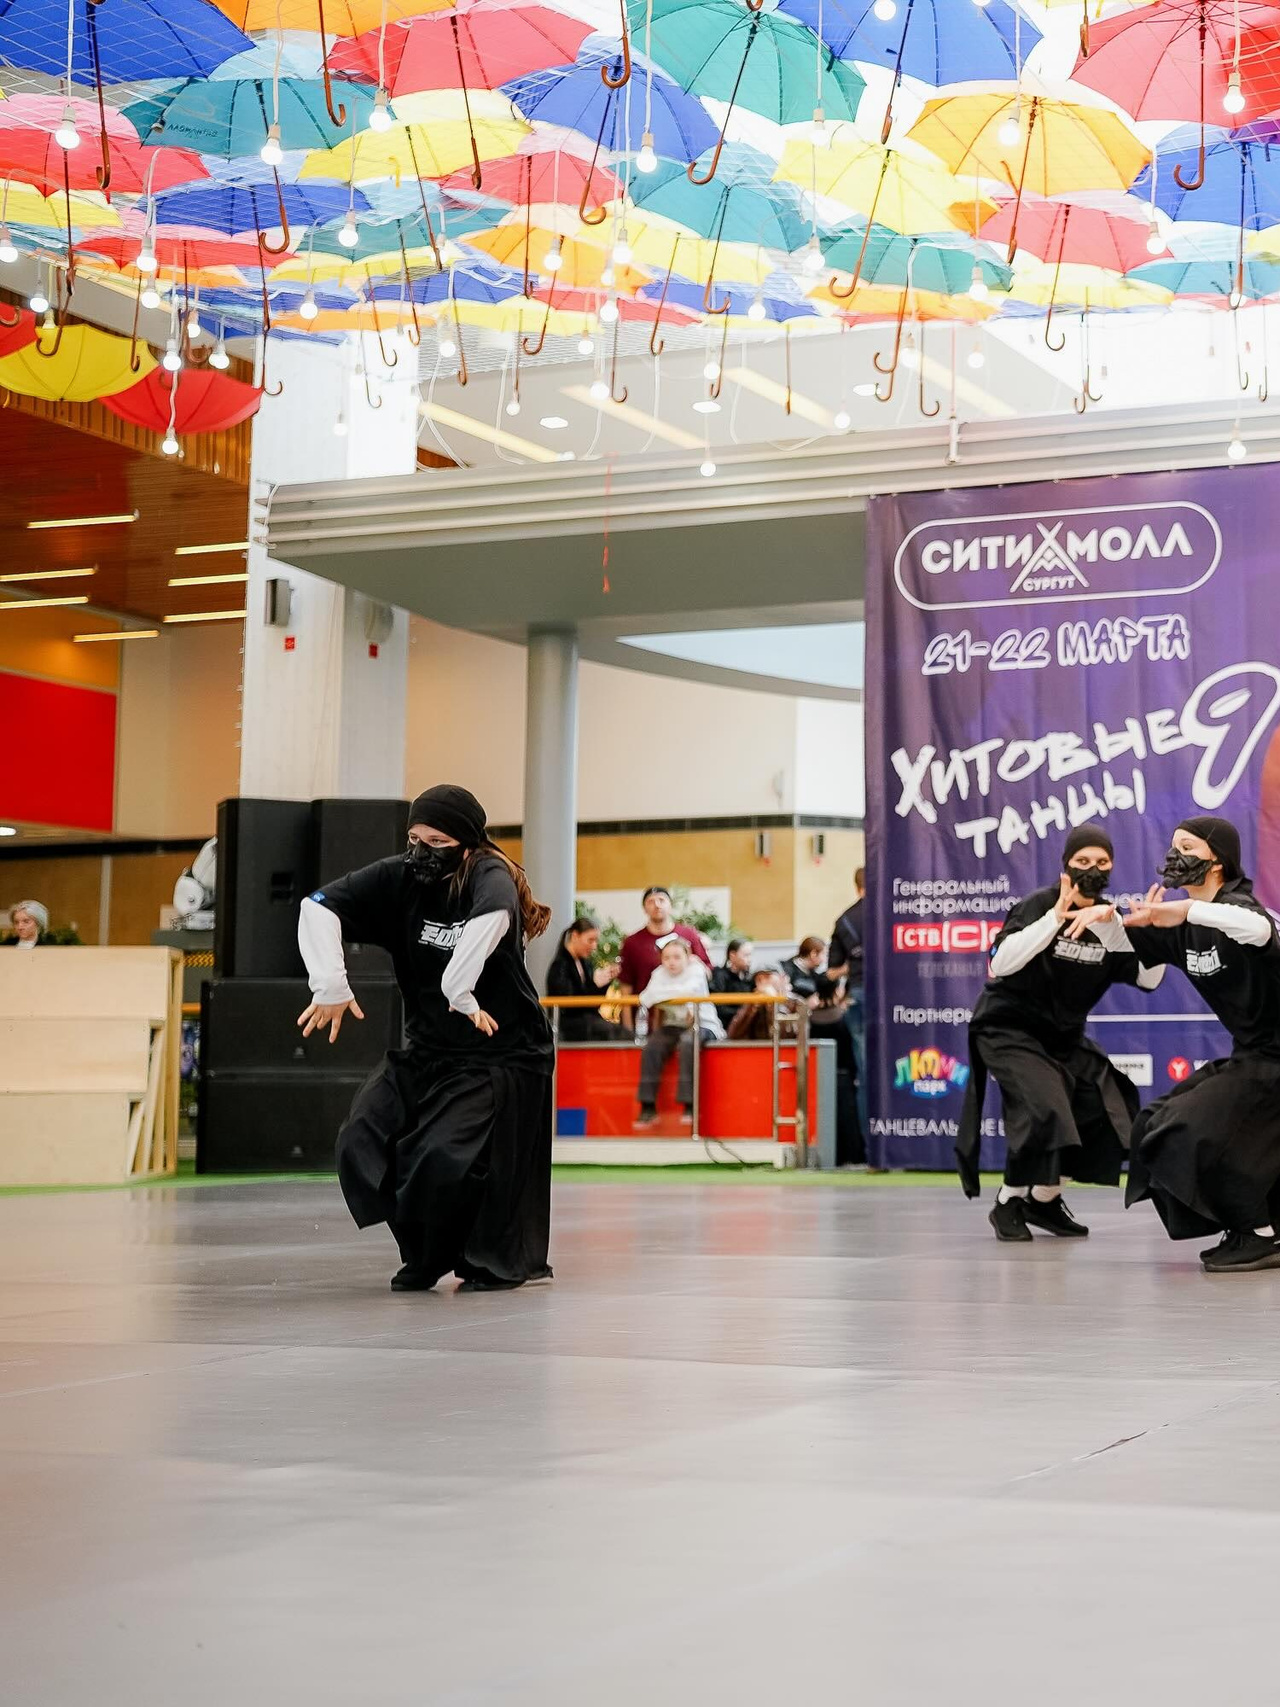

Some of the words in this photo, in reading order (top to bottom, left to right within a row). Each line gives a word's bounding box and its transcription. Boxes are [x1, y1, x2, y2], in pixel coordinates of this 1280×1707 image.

[921, 533, 1033, 574] СИТИ
[1067, 521, 1194, 563] МОЛЛ
[1021, 574, 1076, 592] СУРГУТ
[921, 627, 1051, 676] 21-22
[1056, 613, 1190, 667] МАРТА
[890, 707, 1194, 824] ХИТОВЫЕ
[954, 767, 1147, 859] ТАНЦЫ
[892, 874, 1010, 897] Генеральный
[892, 895, 1022, 917] информацио
